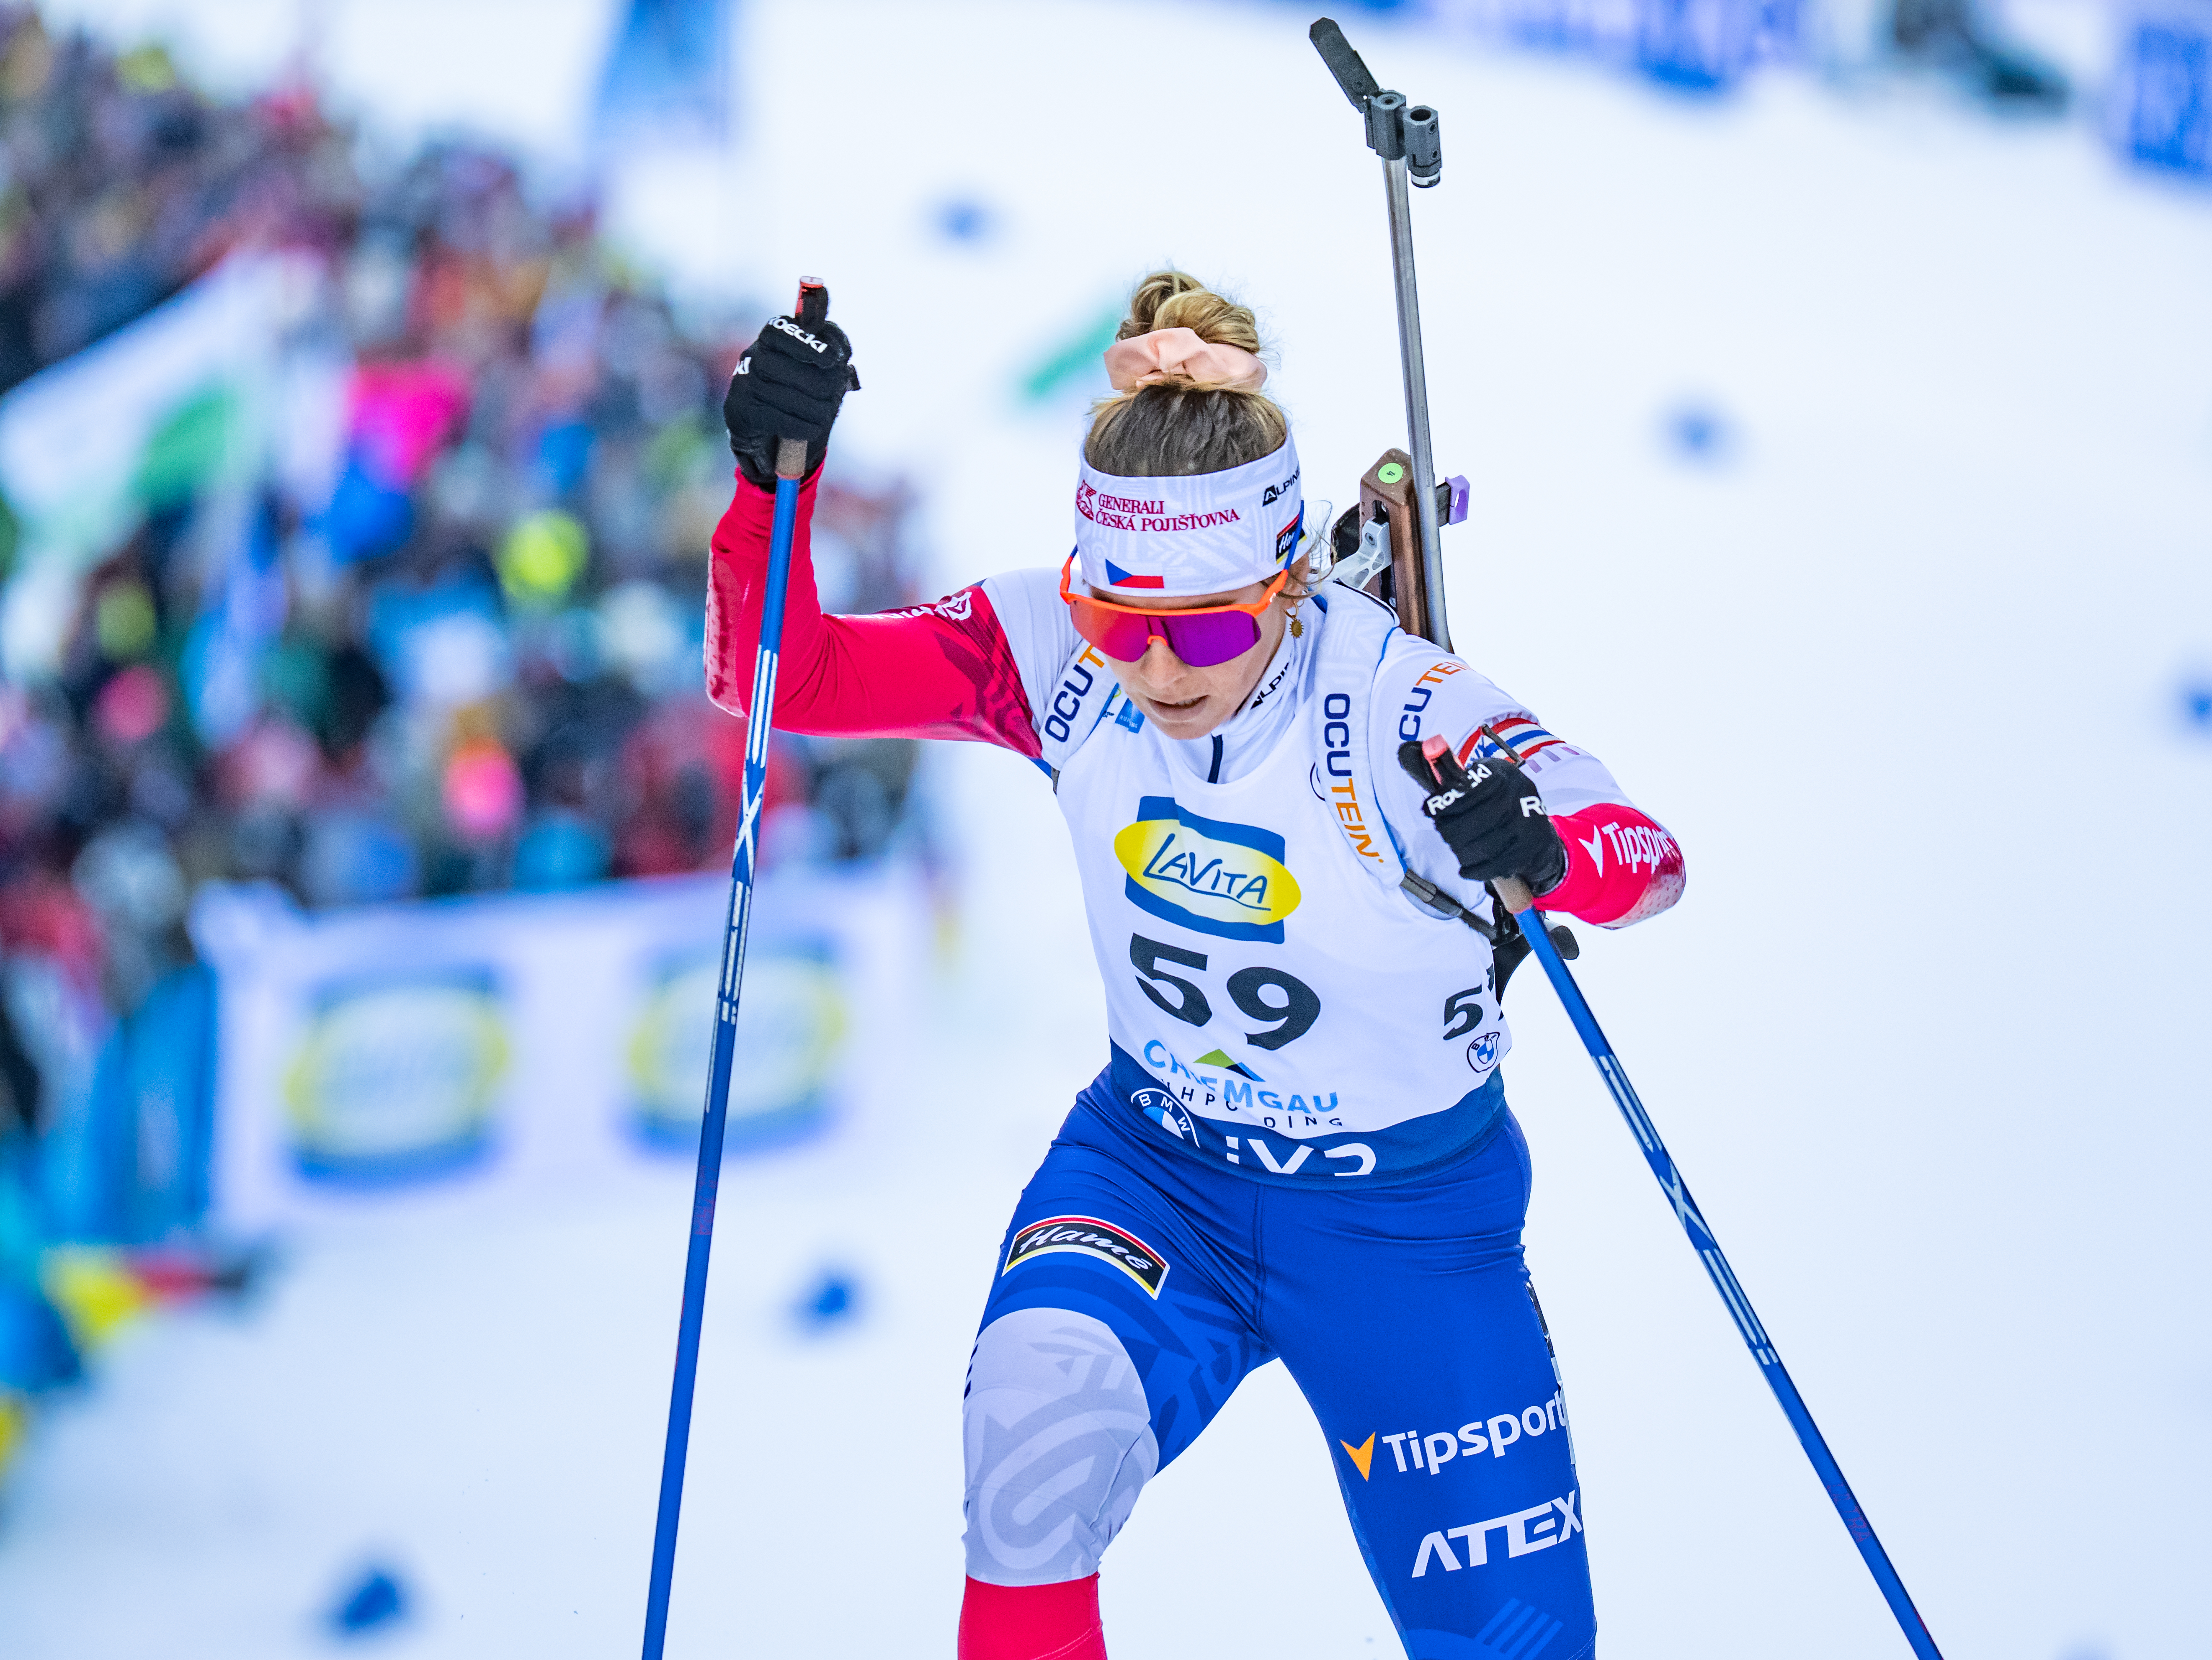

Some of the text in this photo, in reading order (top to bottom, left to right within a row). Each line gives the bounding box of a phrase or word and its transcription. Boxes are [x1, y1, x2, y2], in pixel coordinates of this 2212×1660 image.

[1096, 508, 1241, 532] ČESKÁ POJIŠŤOVNA
[1098, 493, 1164, 515] GENERALI
[1045, 644, 1105, 743] OCUT
[1130, 933, 1321, 1051] 59
[1139, 1094, 1190, 1131] BMW
[1382, 1390, 1568, 1475] Tipsport
[1411, 1490, 1583, 1578] ATEX
